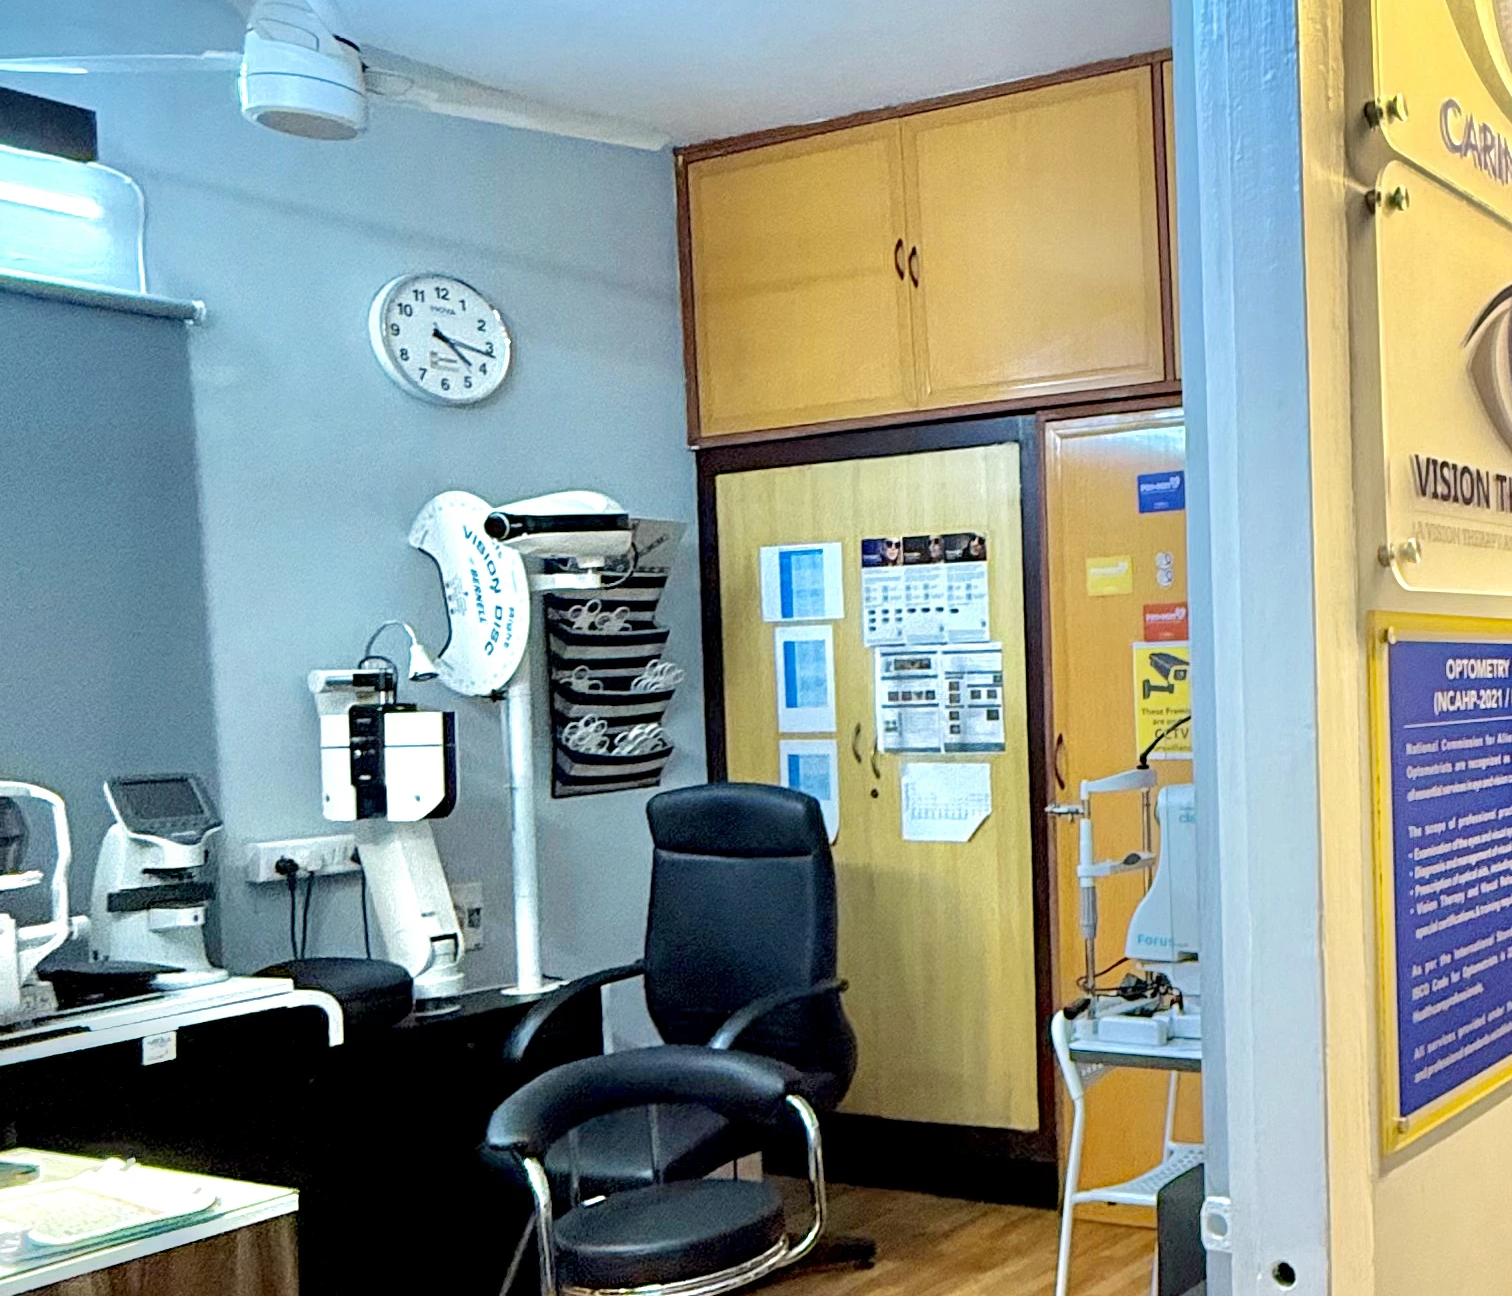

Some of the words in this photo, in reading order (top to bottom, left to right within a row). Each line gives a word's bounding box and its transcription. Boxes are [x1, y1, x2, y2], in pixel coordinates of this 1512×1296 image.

[413, 289, 425, 302] 11
[435, 287, 450, 301] 12
[397, 303, 413, 317] 10
[459, 299, 466, 311] 1
[390, 323, 400, 336] 9
[477, 319, 486, 332] 2
[400, 348, 409, 361] 8
[485, 342, 494, 356] 3
[418, 368, 428, 381] 7
[479, 363, 487, 375] 4
[441, 378, 450, 390] 6
[464, 376, 472, 389] 5
[1412, 454, 1490, 509] VISION
[463, 525, 501, 593] VISION
[484, 605, 503, 656] DISC
[1446, 659, 1509, 679] OPTOMETRY
[1137, 934, 1175, 948] Forus
